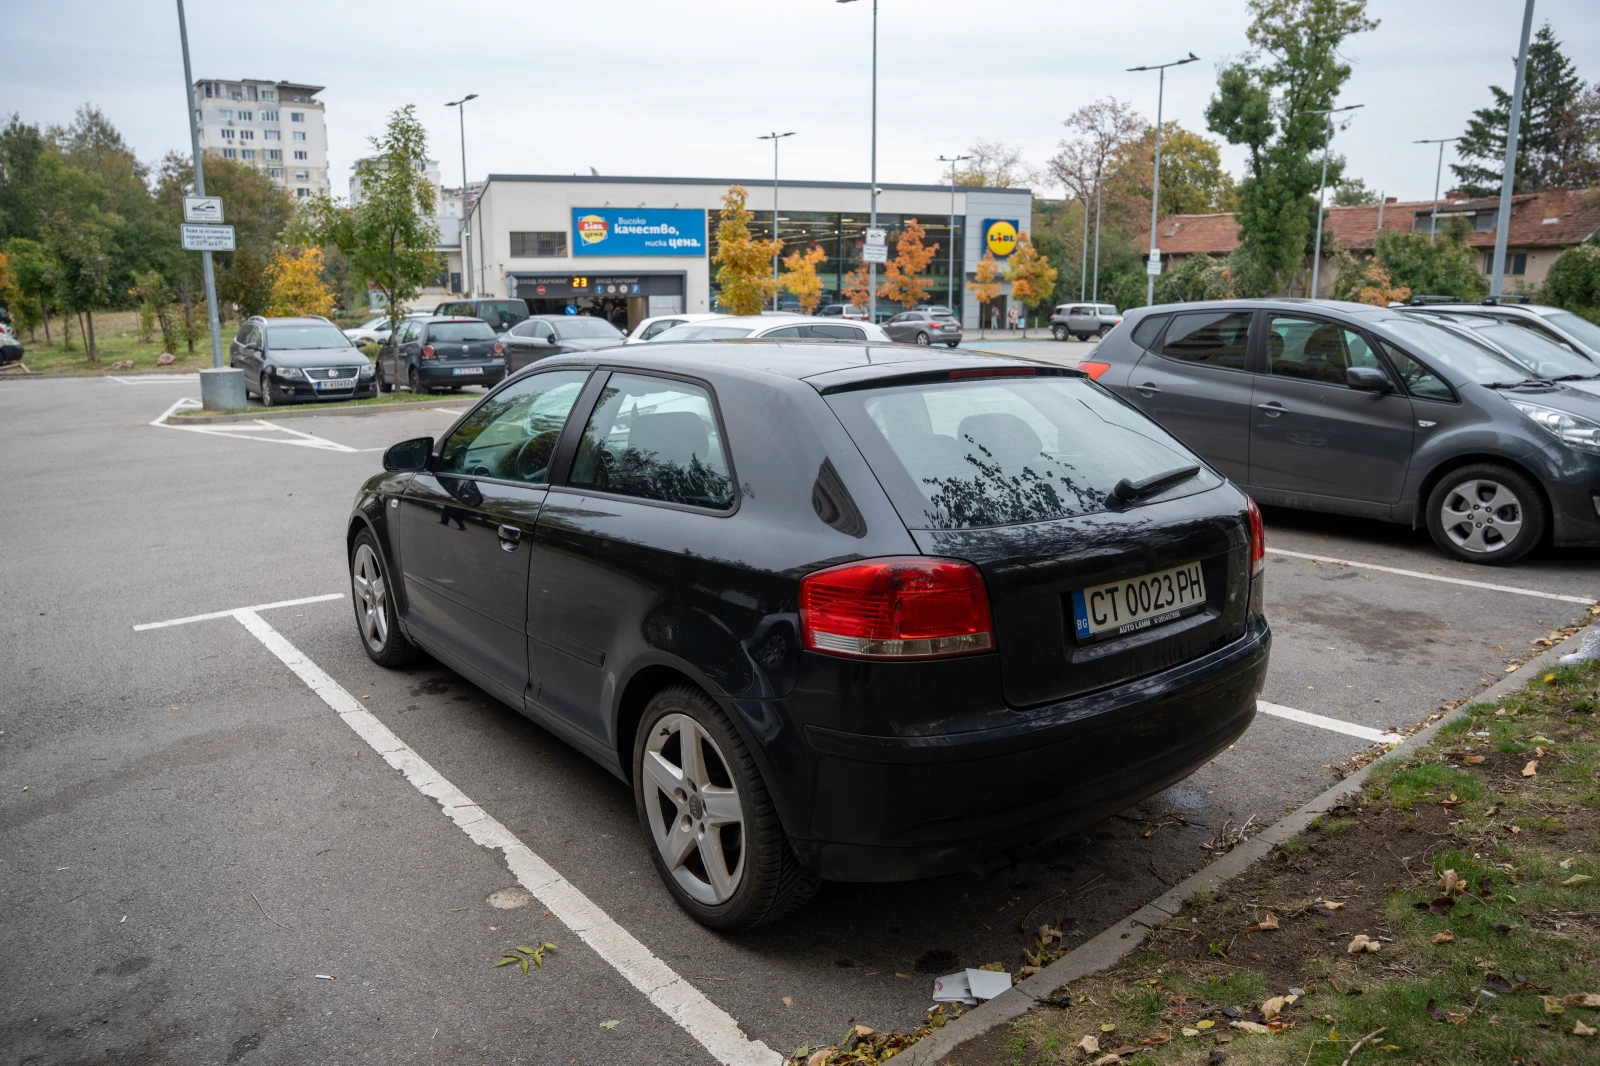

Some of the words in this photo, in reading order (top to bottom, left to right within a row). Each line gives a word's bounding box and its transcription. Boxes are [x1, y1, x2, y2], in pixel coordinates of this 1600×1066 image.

[584, 221, 604, 230] LIDL
[618, 217, 646, 225] Високо
[614, 223, 679, 236] качество,
[585, 232, 603, 240] цена
[990, 232, 1015, 242] LIDL
[645, 239, 667, 247] ниска
[668, 238, 701, 249] цена.
[572, 276, 588, 288] 23
[1076, 619, 1088, 630] BG
[1119, 621, 1135, 634] AUTO
